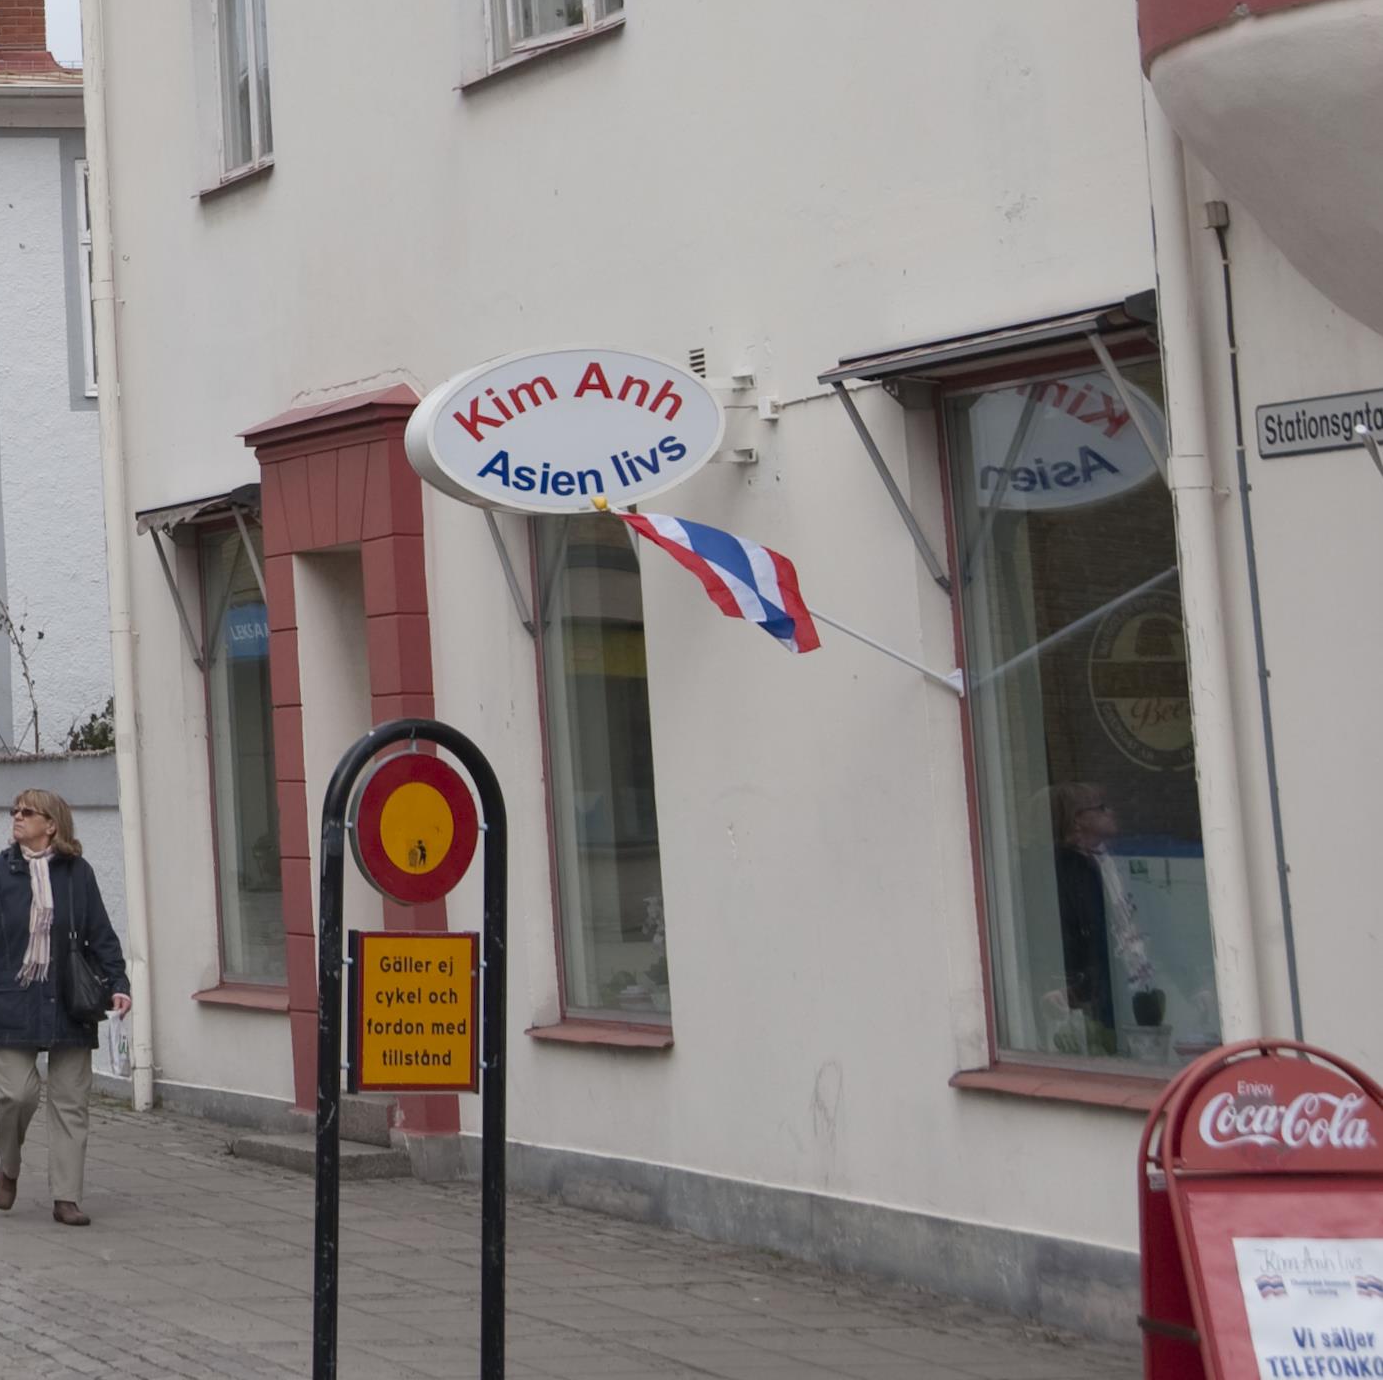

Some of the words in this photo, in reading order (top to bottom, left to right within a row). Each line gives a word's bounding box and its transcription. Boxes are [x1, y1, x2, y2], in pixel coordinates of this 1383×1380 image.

[452, 373, 558, 442] Kim
[574, 361, 684, 420] Anh
[477, 449, 605, 496] Asien
[611, 433, 687, 488] livs
[379, 955, 432, 973] Gäller
[438, 956, 454, 976] ej
[375, 987, 422, 1008] cykel
[428, 987, 458, 1004] och
[366, 1018, 425, 1036] fordon
[431, 1018, 467, 1036] med
[381, 1048, 452, 1068] tillstånd
[1236, 1080, 1275, 1097] Enjoy
[1292, 1326, 1316, 1349] Vi
[1320, 1326, 1376, 1352] säljer
